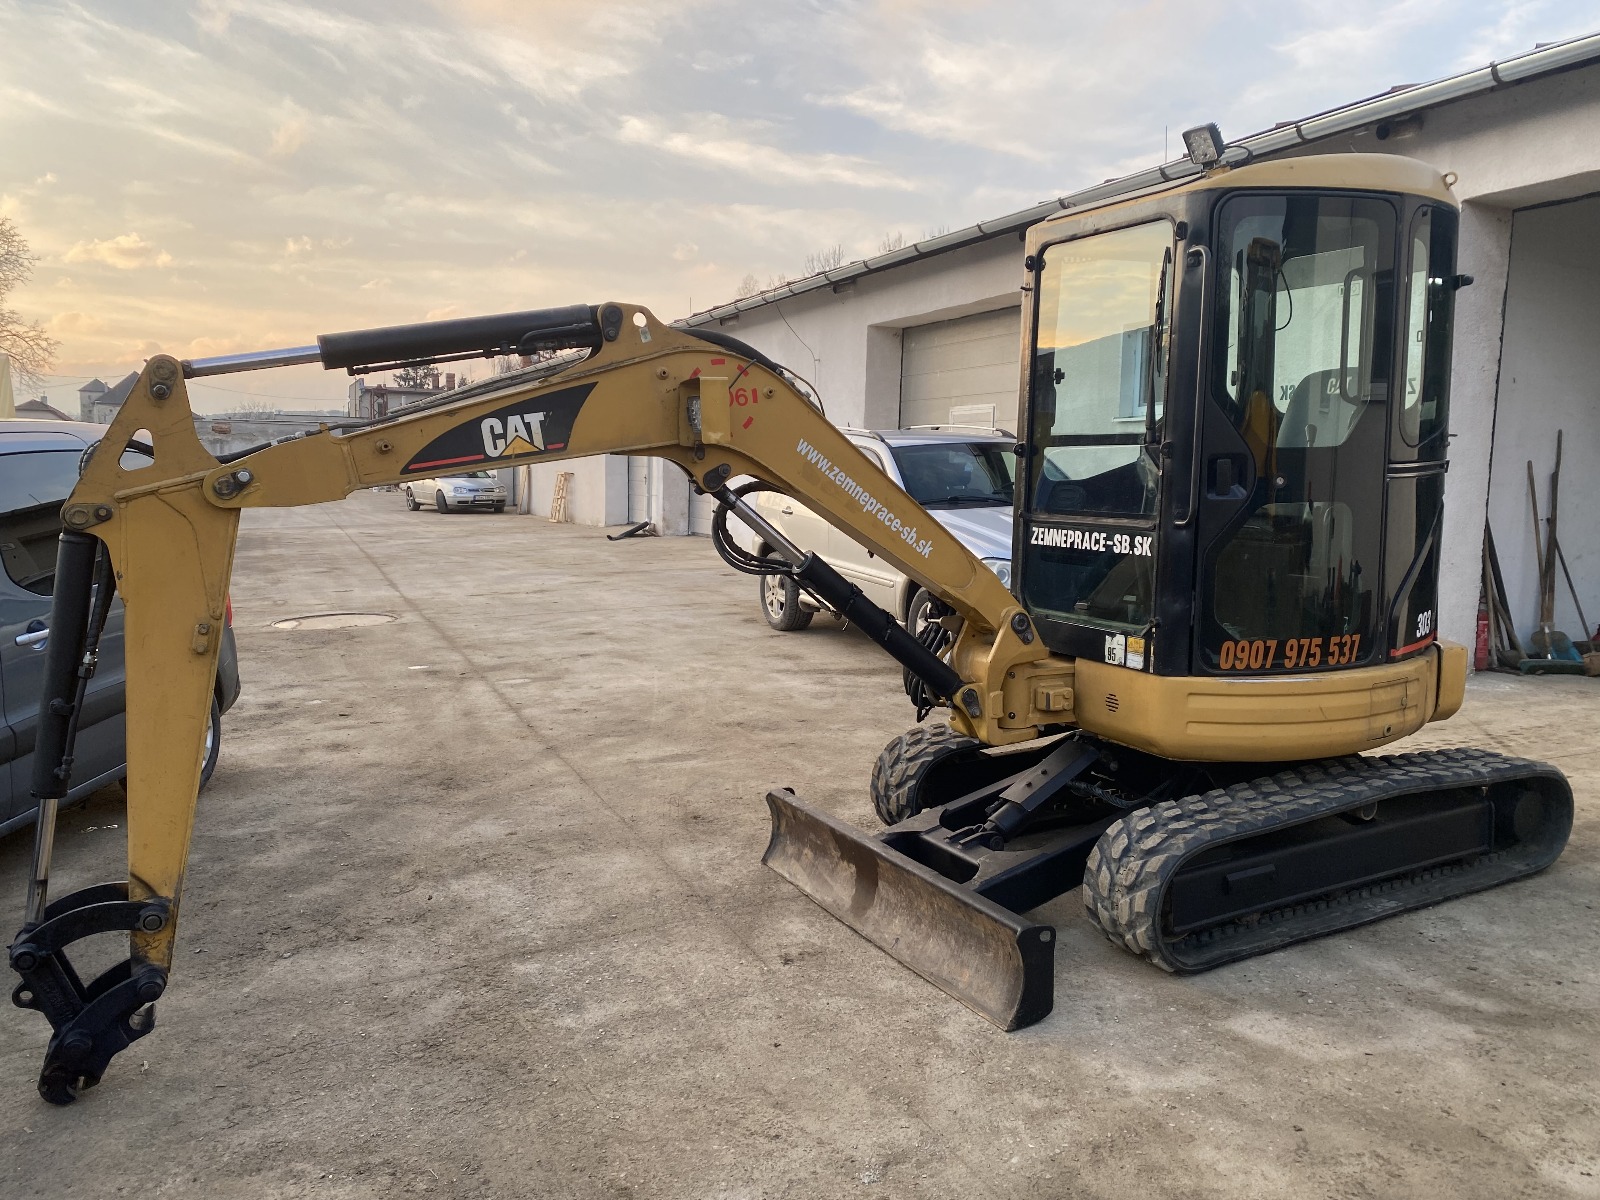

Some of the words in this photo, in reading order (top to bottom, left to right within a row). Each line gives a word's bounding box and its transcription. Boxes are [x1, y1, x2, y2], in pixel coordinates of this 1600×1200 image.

[481, 411, 545, 458] CAT
[796, 438, 934, 559] www.zemneprace-sb.sk
[1030, 526, 1153, 557] ZEMNEPRACE-SB.SK
[1416, 609, 1432, 638] 303
[1219, 639, 1278, 670] 0907
[1284, 637, 1323, 669] 975
[1327, 633, 1361, 666] 537
